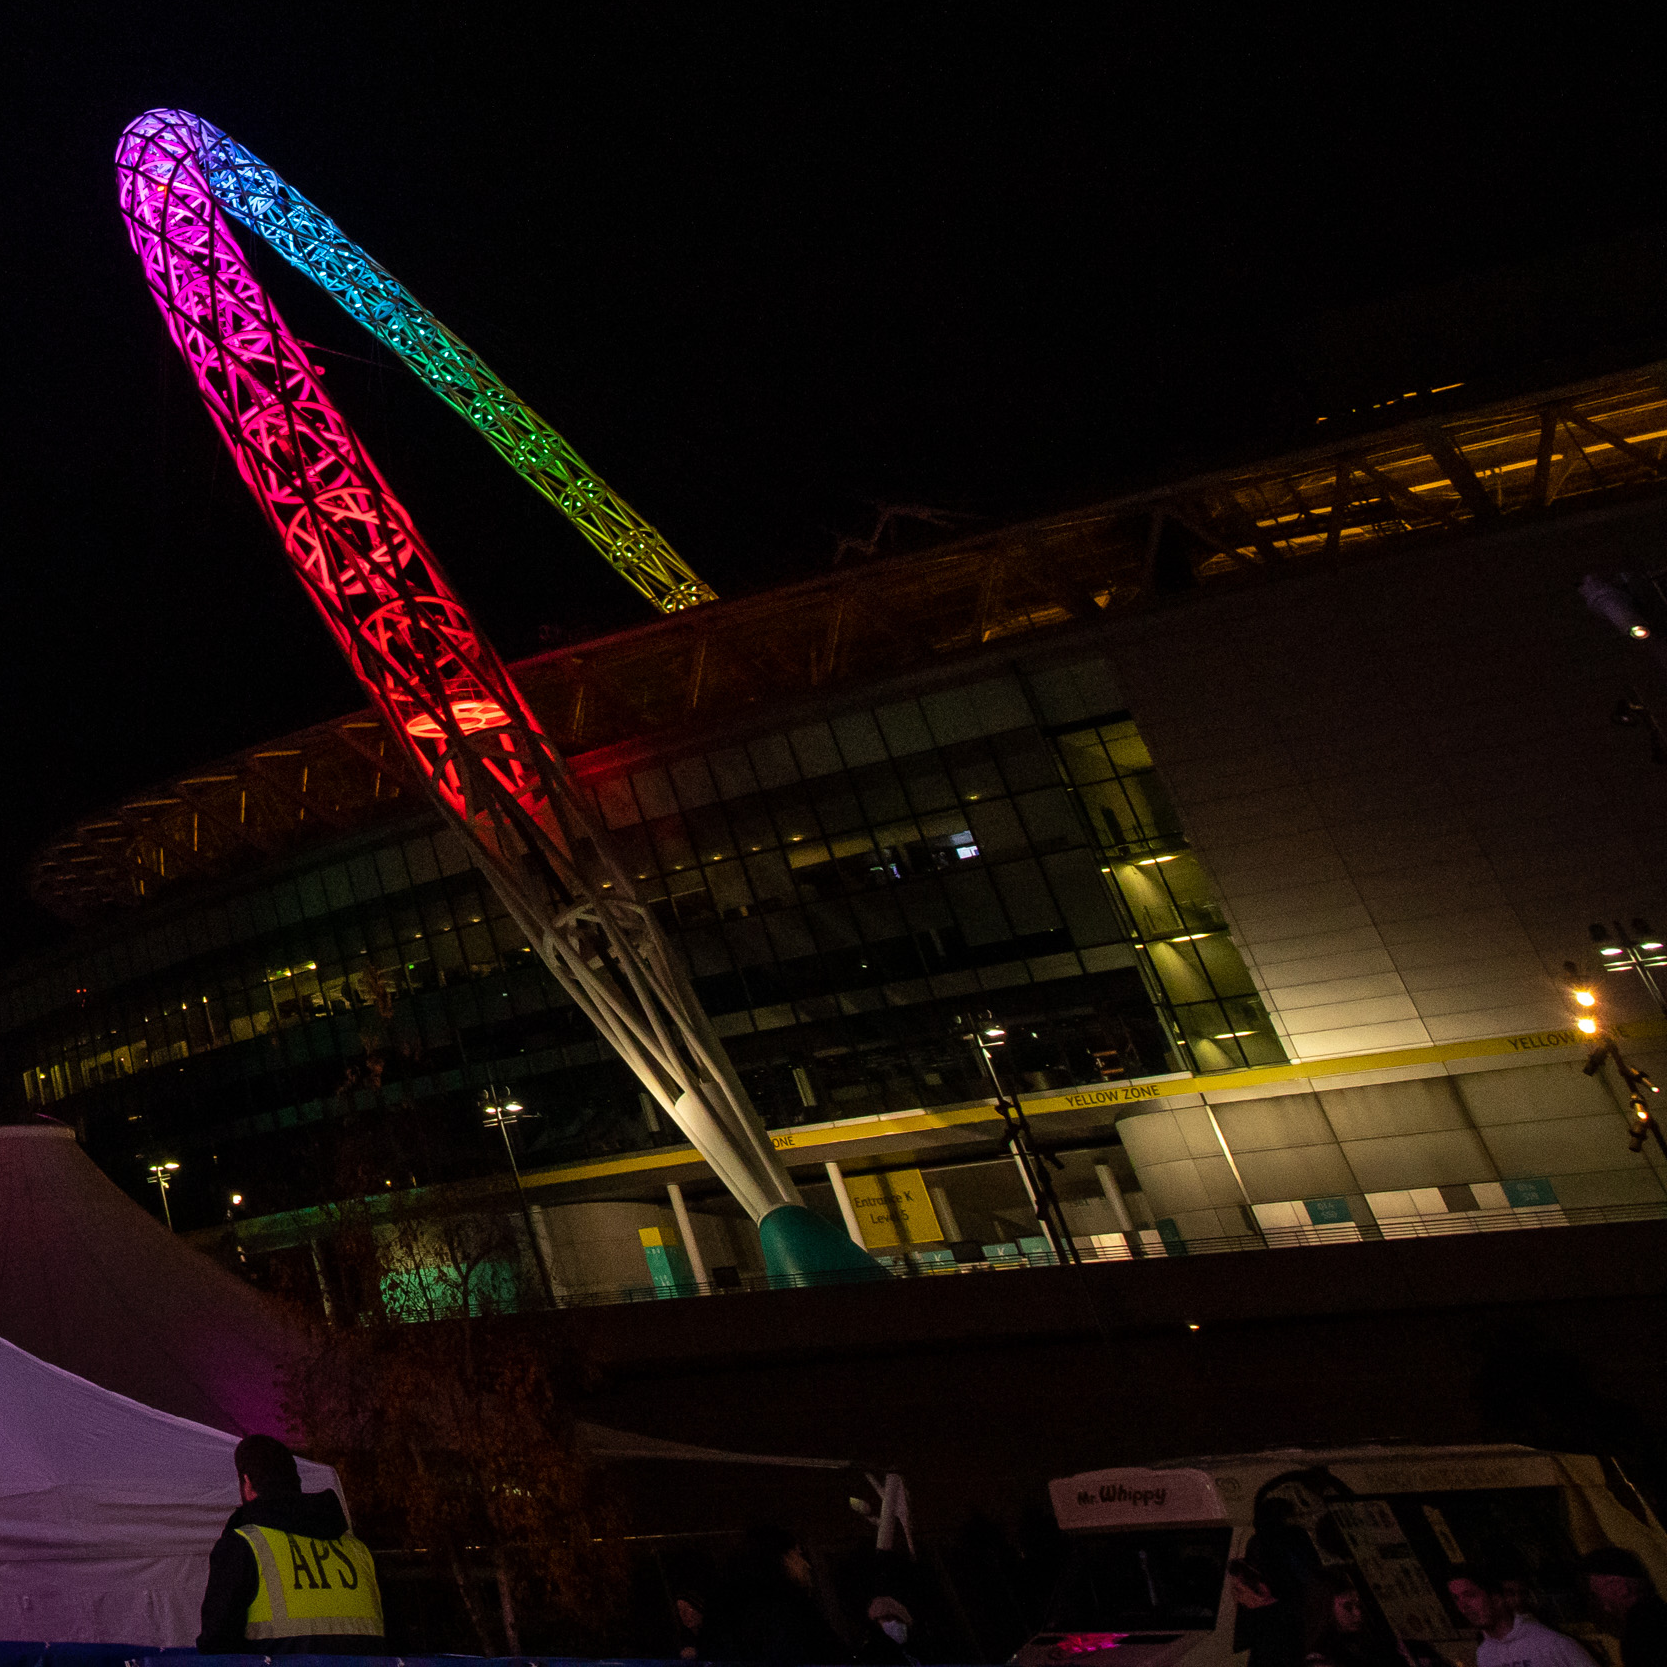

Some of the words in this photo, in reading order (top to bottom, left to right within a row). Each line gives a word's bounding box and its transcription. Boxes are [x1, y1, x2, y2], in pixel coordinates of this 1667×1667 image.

[1065, 1089, 1120, 1107] YELLOW
[1121, 1084, 1161, 1101] ZONE
[771, 1134, 796, 1149] ONE
[853, 1194, 903, 1209] Entrae
[869, 1213, 899, 1224] Lev
[1099, 1483, 1166, 1506] Whippy
[285, 1532, 358, 1590] APS
